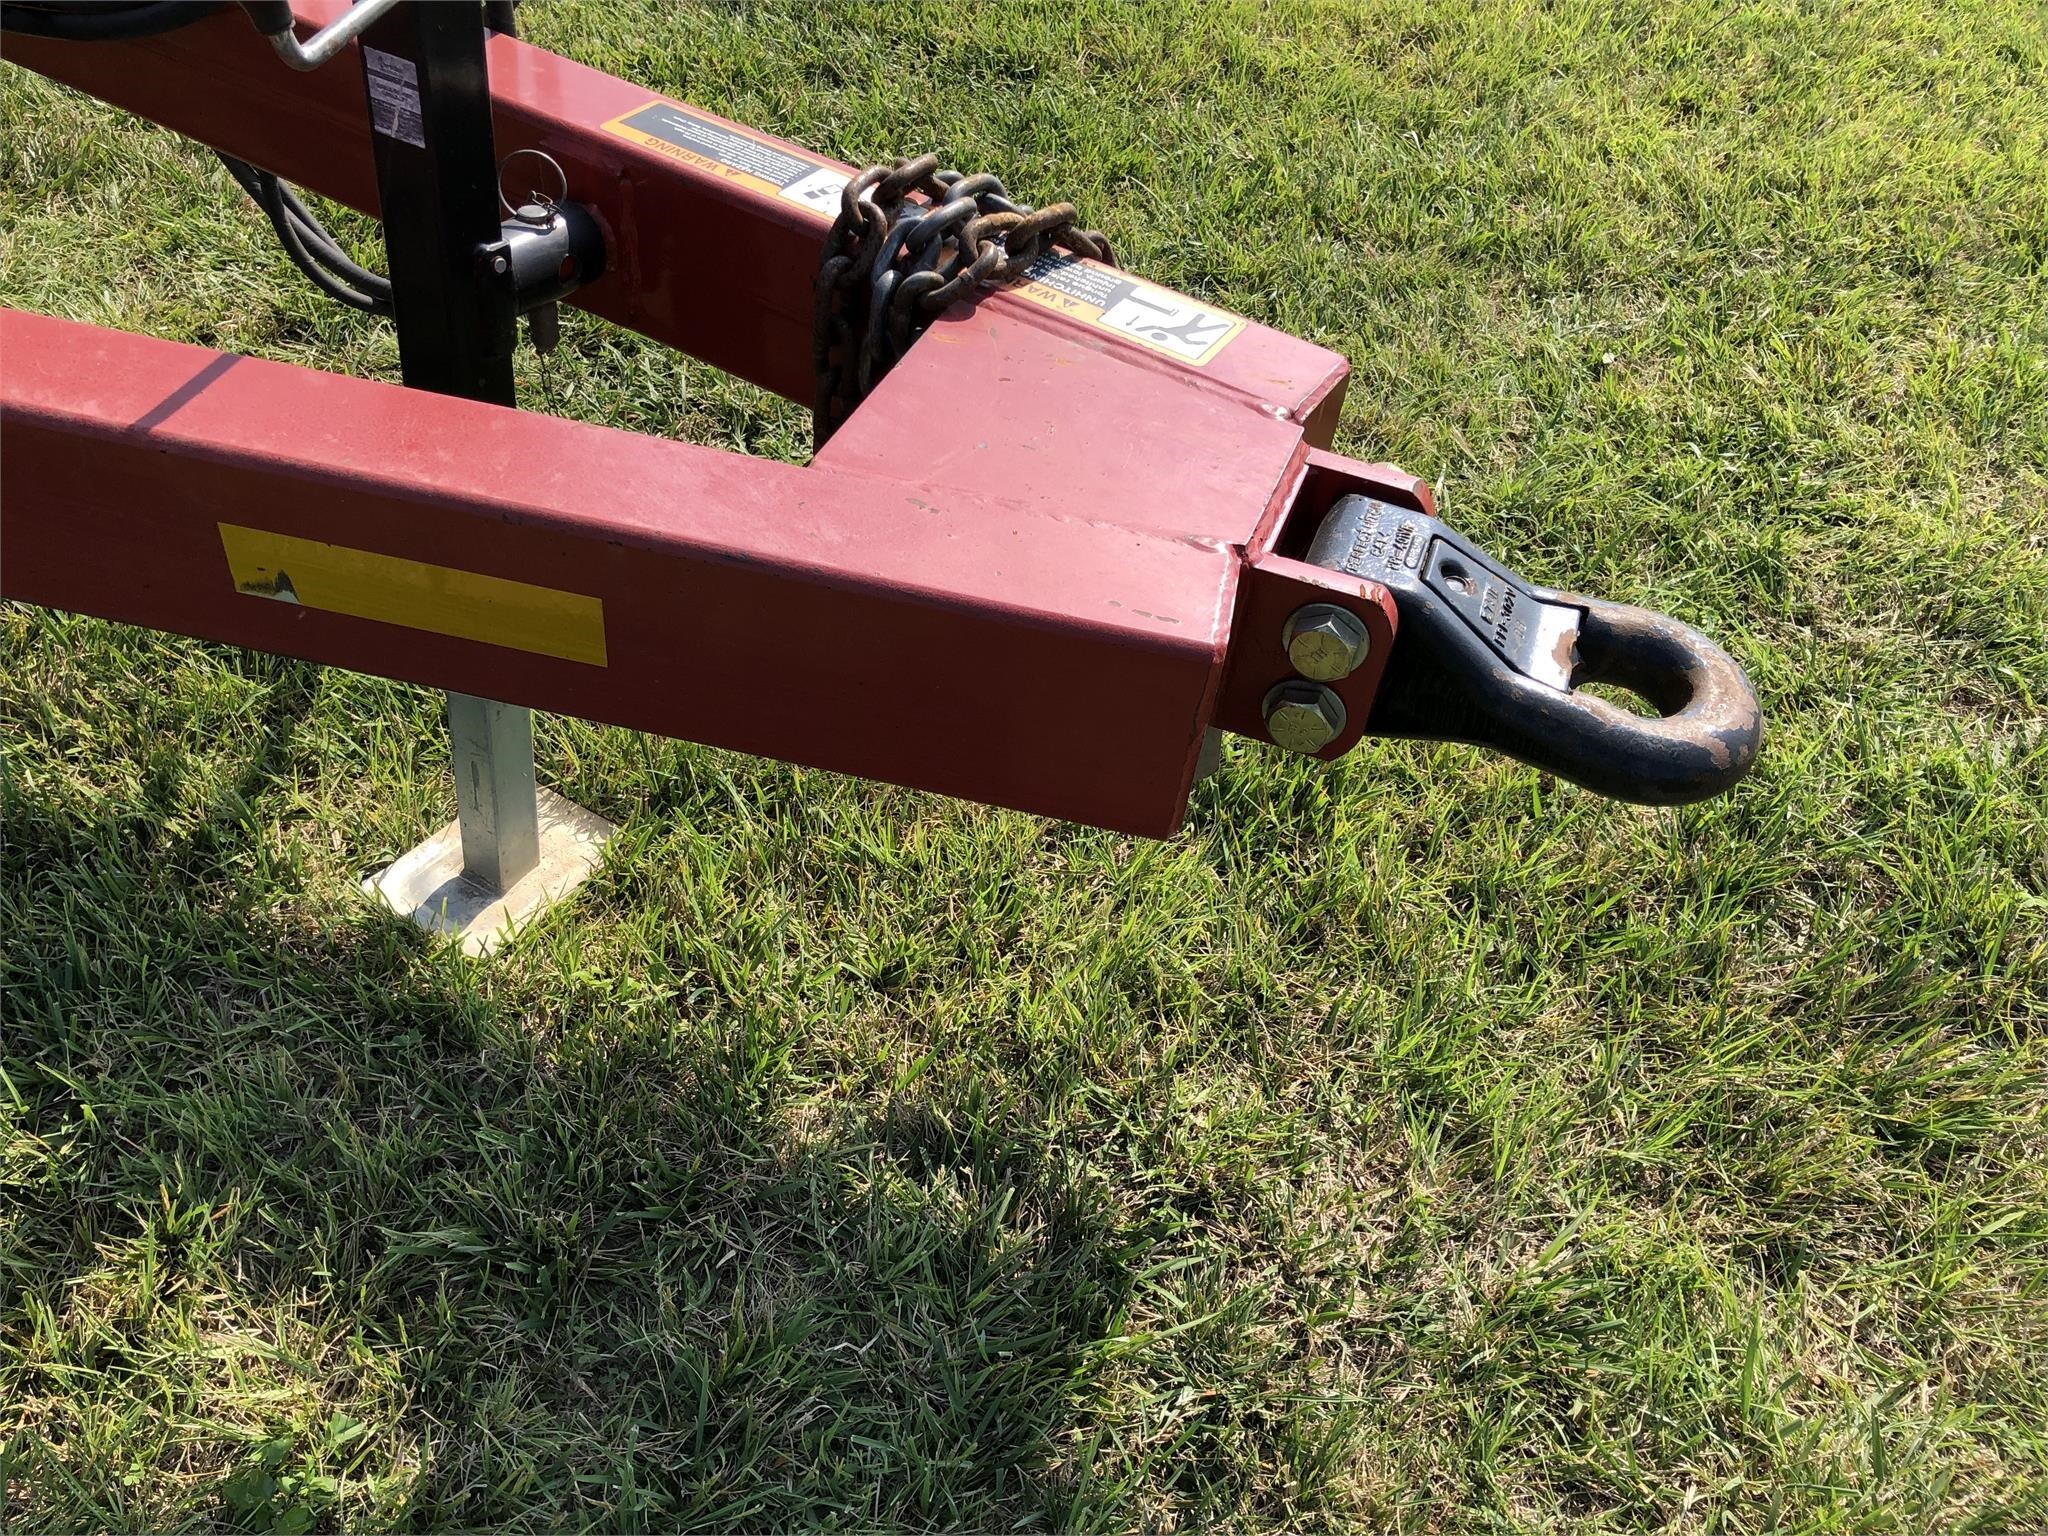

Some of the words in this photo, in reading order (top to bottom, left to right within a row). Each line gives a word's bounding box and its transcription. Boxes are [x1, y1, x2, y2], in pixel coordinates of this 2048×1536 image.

[644, 137, 720, 170] WARNING
[720, 158, 753, 175] HAZARD
[753, 170, 785, 186] TOWING
[1083, 269, 1122, 285] ground
[1020, 269, 1107, 307] UNHITCHING
[1072, 281, 1108, 299] Tongue
